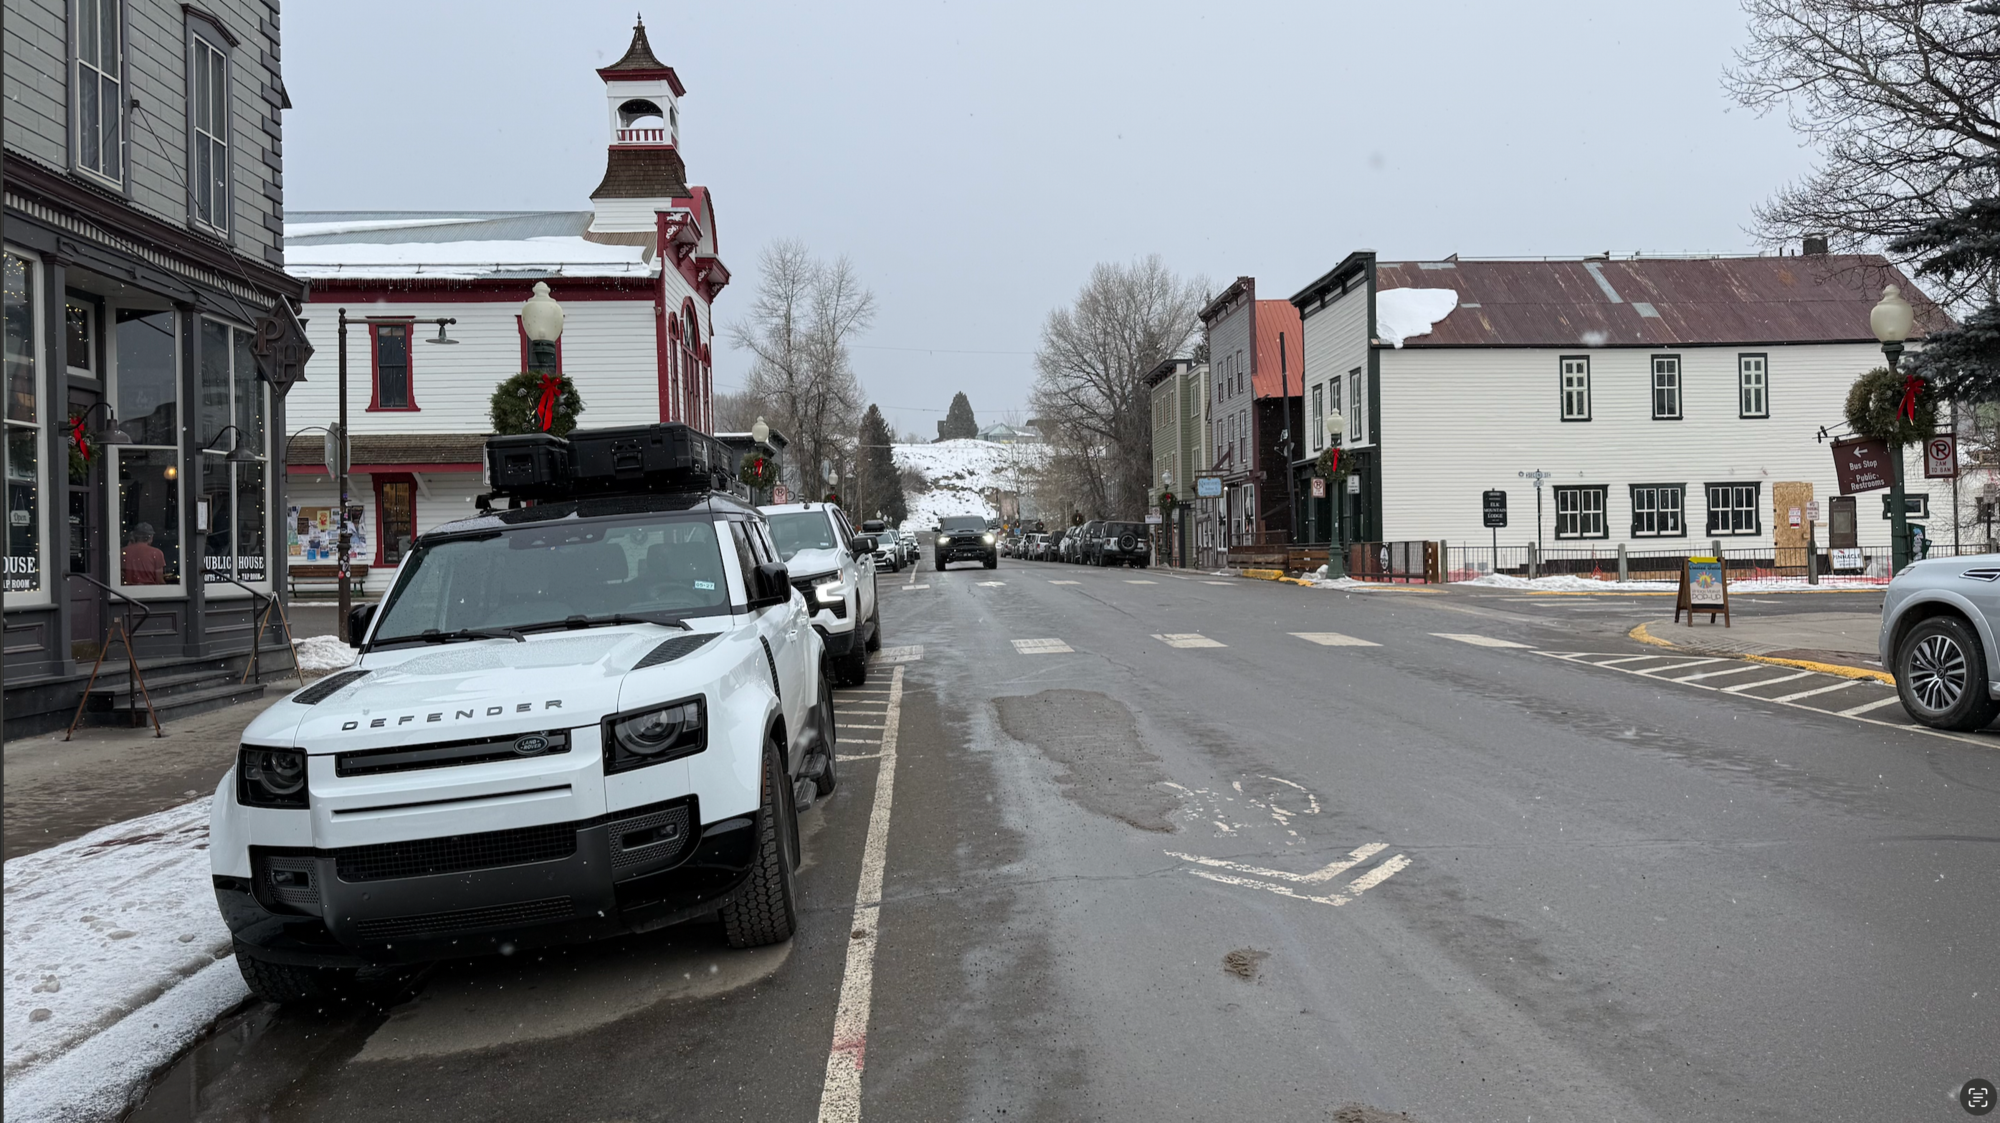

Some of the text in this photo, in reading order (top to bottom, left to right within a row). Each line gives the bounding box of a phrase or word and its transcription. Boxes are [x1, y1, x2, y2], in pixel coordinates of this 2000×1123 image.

[1863, 460, 1877, 468] Stop
[1856, 472, 1876, 482] Public
[1850, 478, 1885, 490] Restrooms
[13, 512, 27, 522] Open
[238, 556, 264, 569] HOUSE
[11, 579, 30, 588] ROOM
[341, 699, 563, 731] DEFENDER
